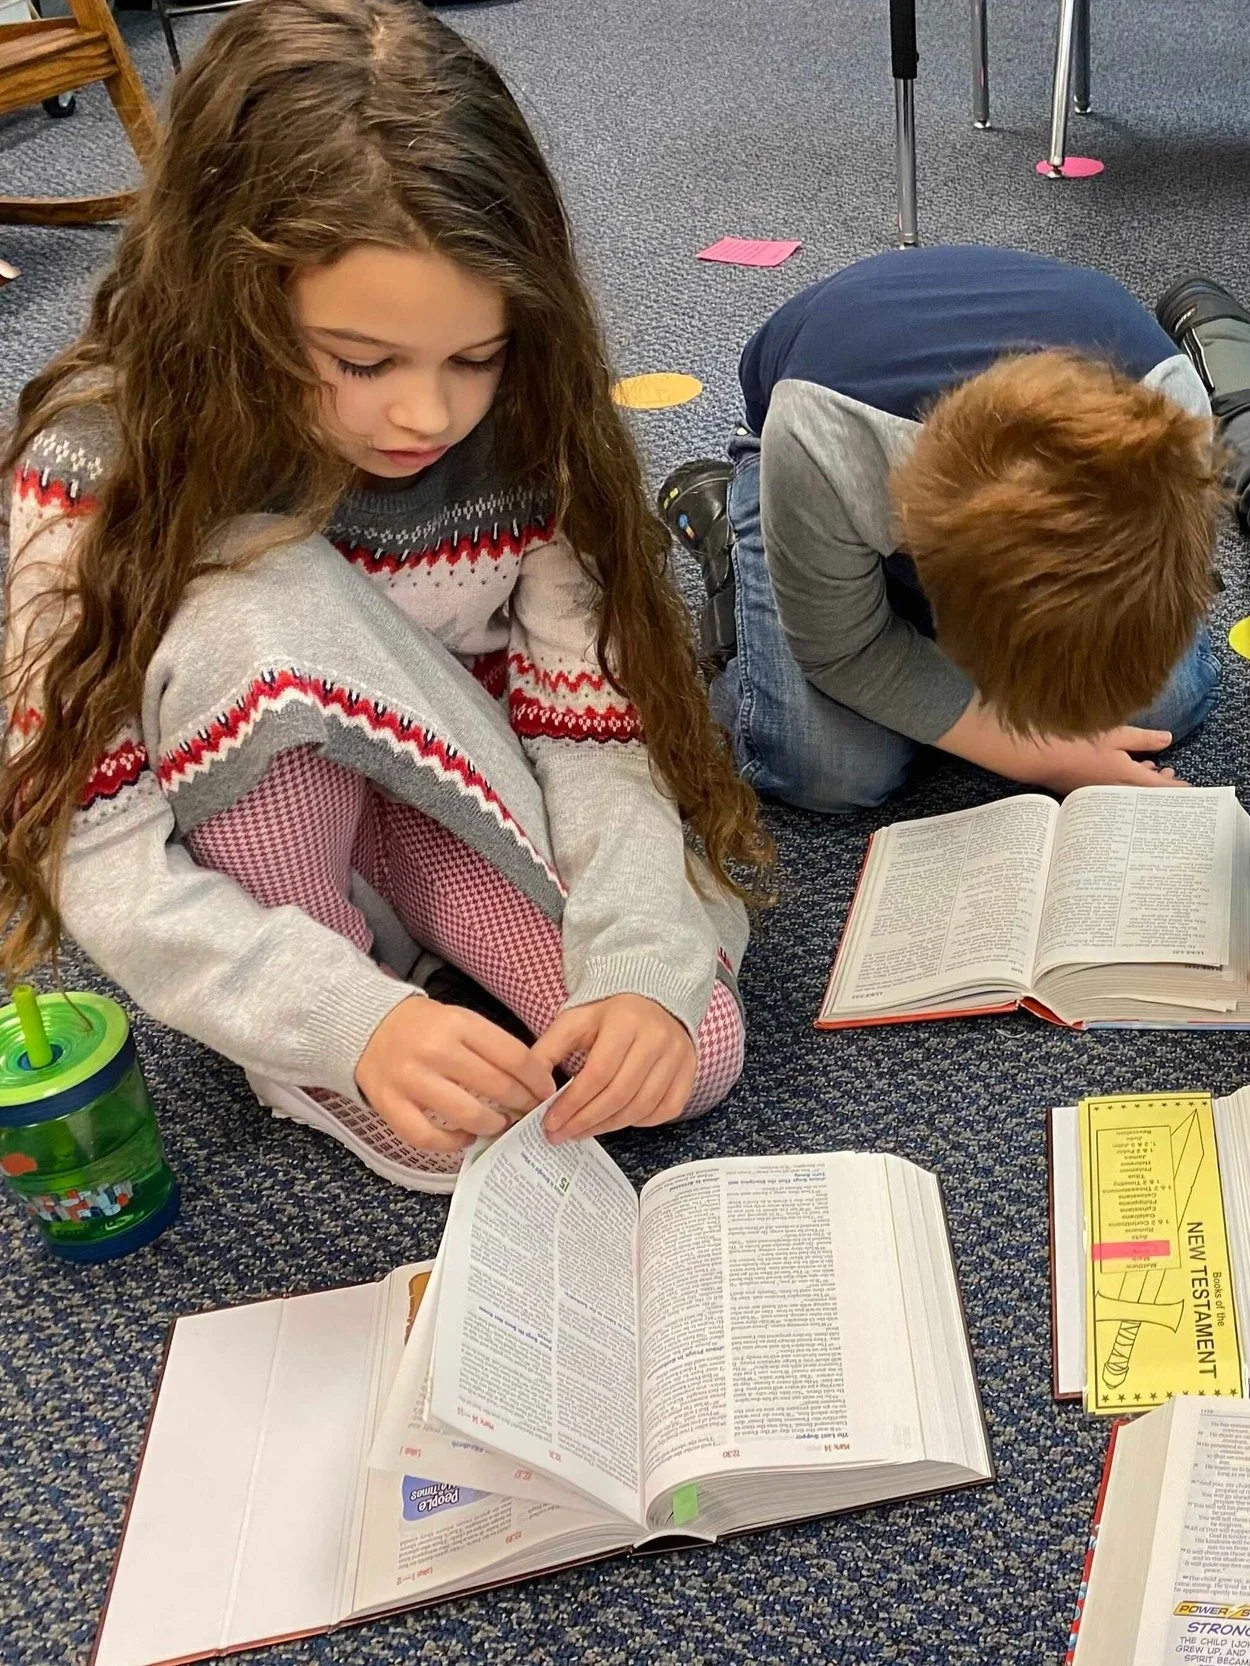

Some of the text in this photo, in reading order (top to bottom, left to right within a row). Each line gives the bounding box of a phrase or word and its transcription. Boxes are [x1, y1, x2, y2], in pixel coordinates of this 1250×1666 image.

[1187, 1222, 1218, 1379] NEW TESTAMENT
[1212, 1271, 1226, 1327] Books of the
[410, 1485, 437, 1500] Times
[418, 1490, 458, 1511] People
[1179, 1605, 1228, 1615] POWER
[1200, 1638, 1228, 1646] CHILD
[1175, 1645, 1204, 1654] GREW
[1207, 1647, 1222, 1655] UP,
[1226, 1649, 1246, 1657] AND
[1184, 1655, 1213, 1663] SPIRIT
